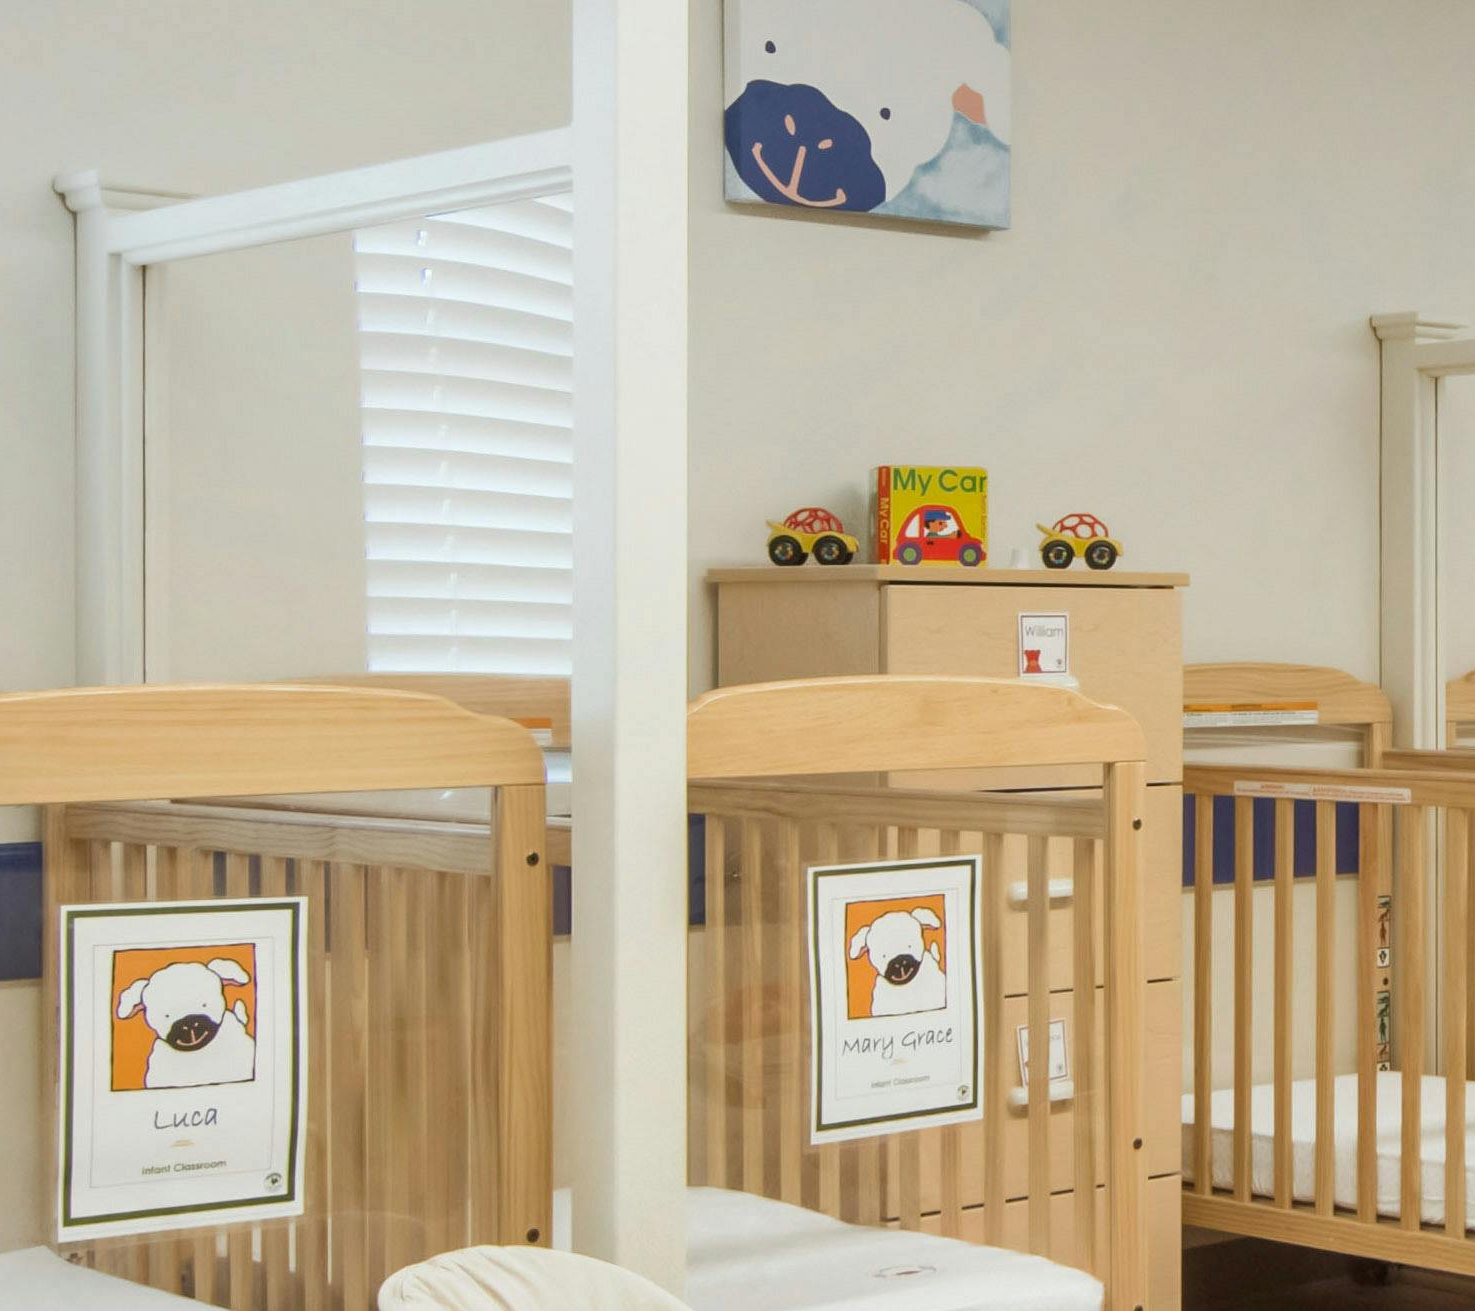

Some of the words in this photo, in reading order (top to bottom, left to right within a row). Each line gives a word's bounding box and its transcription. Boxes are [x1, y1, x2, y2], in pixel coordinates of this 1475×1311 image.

[892, 468, 932, 496] My
[938, 469, 987, 493] Car
[842, 1035, 894, 1060] Mary
[901, 1027, 954, 1051] Grace
[154, 1107, 218, 1130] Luca
